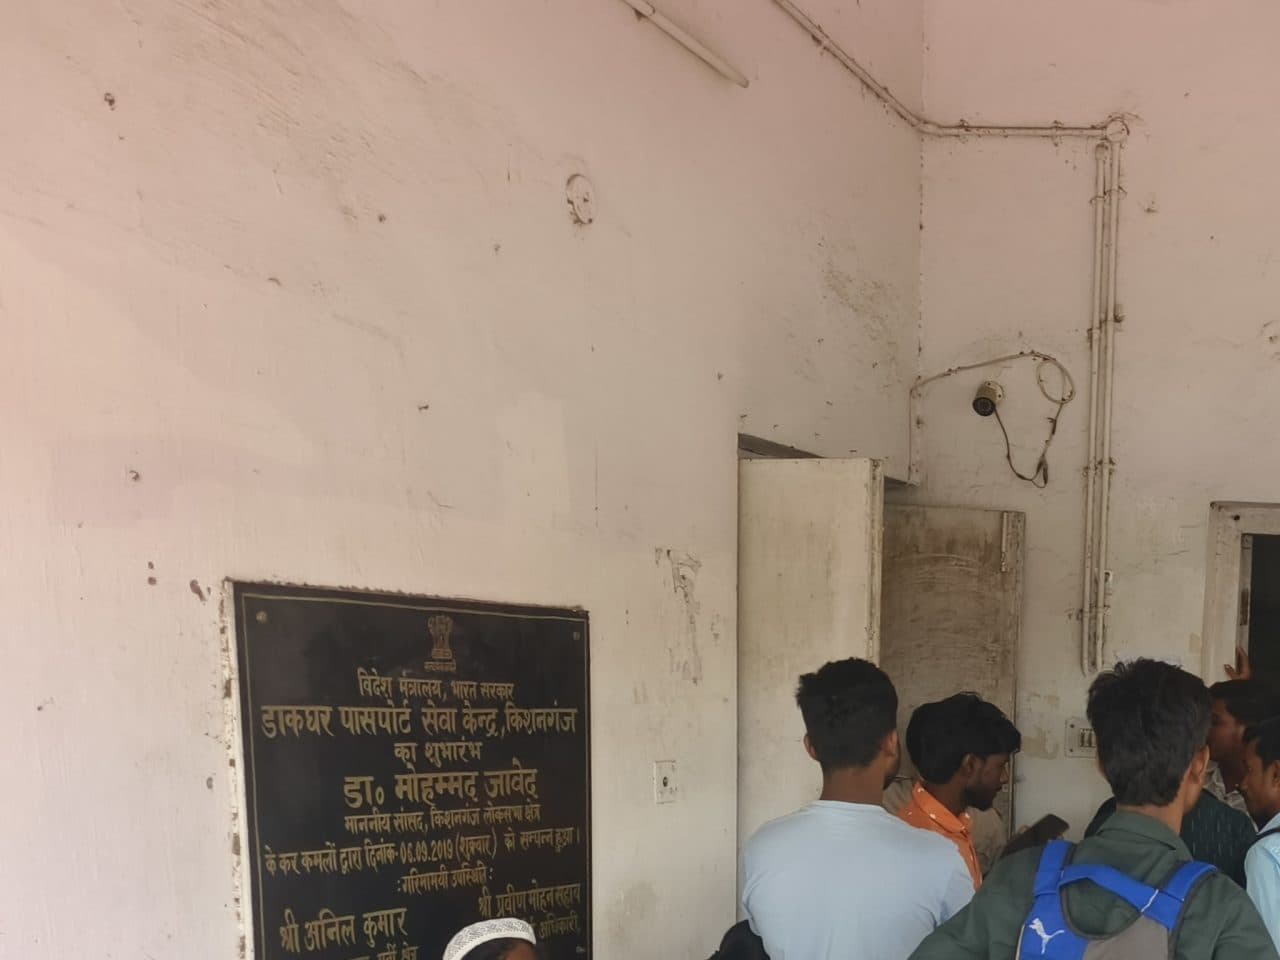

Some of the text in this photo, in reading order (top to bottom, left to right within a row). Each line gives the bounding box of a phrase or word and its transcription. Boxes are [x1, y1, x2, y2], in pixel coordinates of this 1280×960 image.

[356, 667, 392, 698] विदेश
[450, 679, 477, 700] भारत
[480, 682, 514, 700] सरकार
[261, 704, 335, 738] डाकघर
[338, 699, 411, 735] पासपोर्ट
[421, 699, 457, 736] सेवा
[394, 736, 483, 768] का शुभारंभ
[394, 762, 479, 805] मोहम्मद
[483, 757, 538, 799] जावेद
[344, 807, 391, 834] माननीय
[430, 803, 481, 829] किशनगंज
[265, 844, 277, 877] के
[279, 852, 300, 877] कर
[301, 841, 338, 873] कमलों
[339, 846, 362, 875] द्वारा
[504, 827, 516, 852] को
[478, 885, 492, 918] श्री
[280, 907, 408, 953] श्री अनिल कुमार
